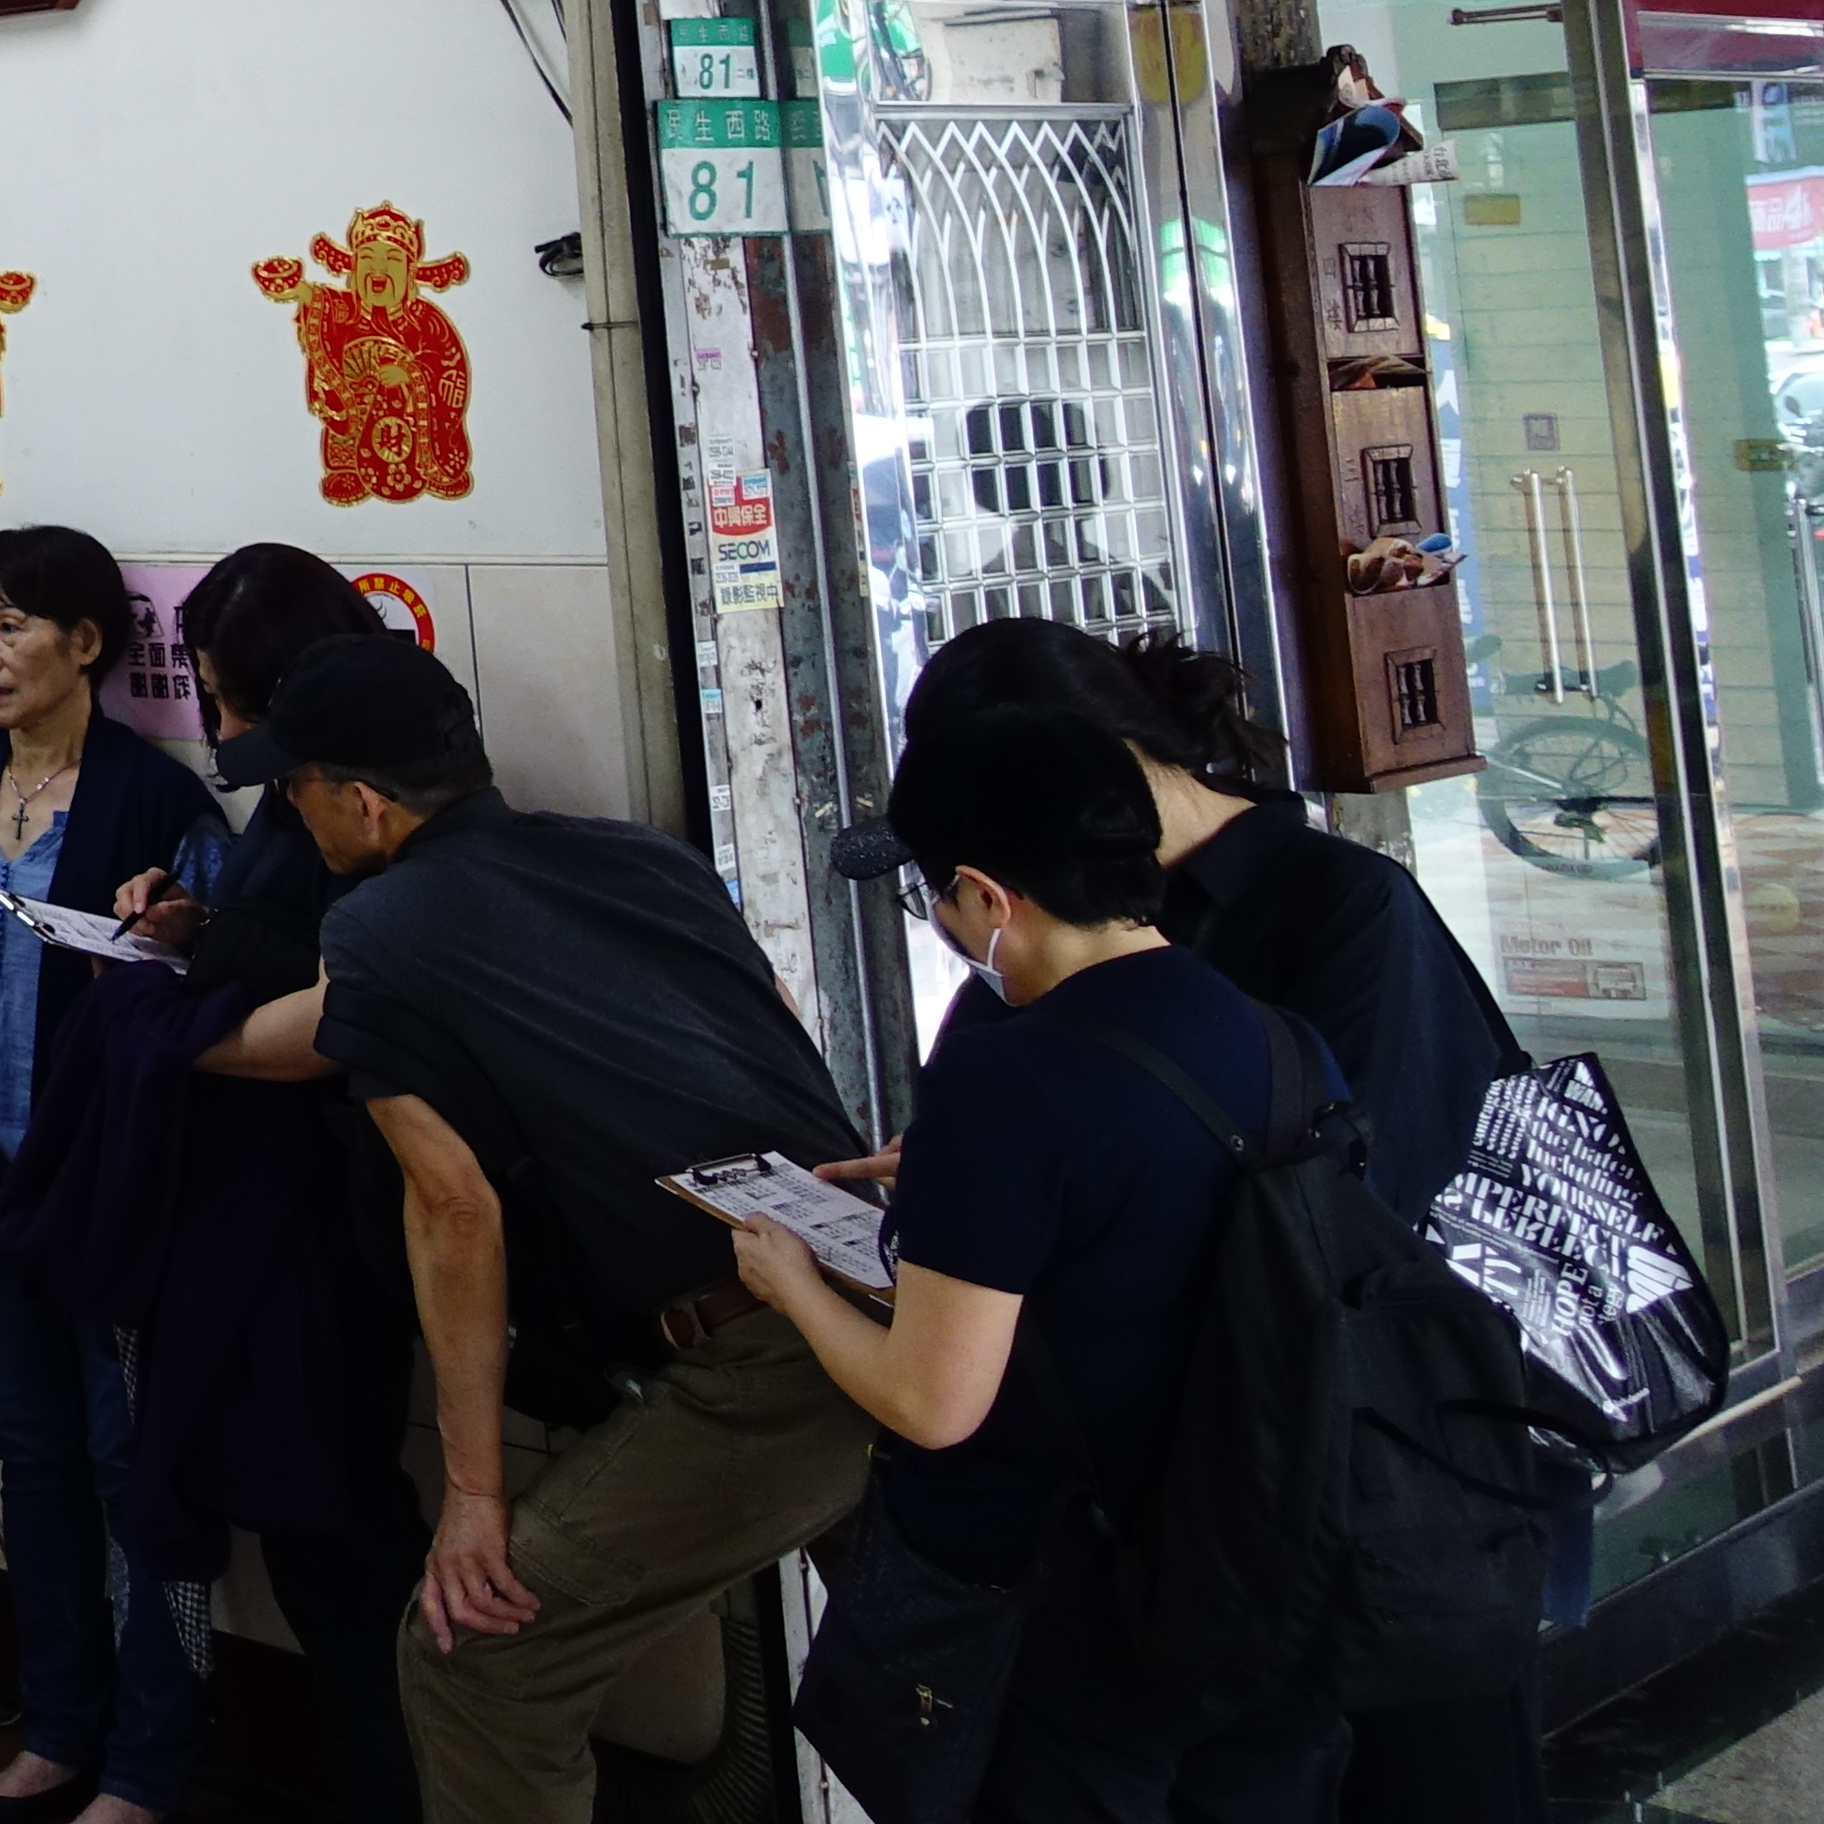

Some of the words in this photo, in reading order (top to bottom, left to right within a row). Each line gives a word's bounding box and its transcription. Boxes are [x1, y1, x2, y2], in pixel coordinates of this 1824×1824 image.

[699, 53, 731, 89] 81
[689, 160, 754, 221] 81
[718, 540, 770, 561] SECOM
[1521, 1163, 1665, 1242] YOURSELF
